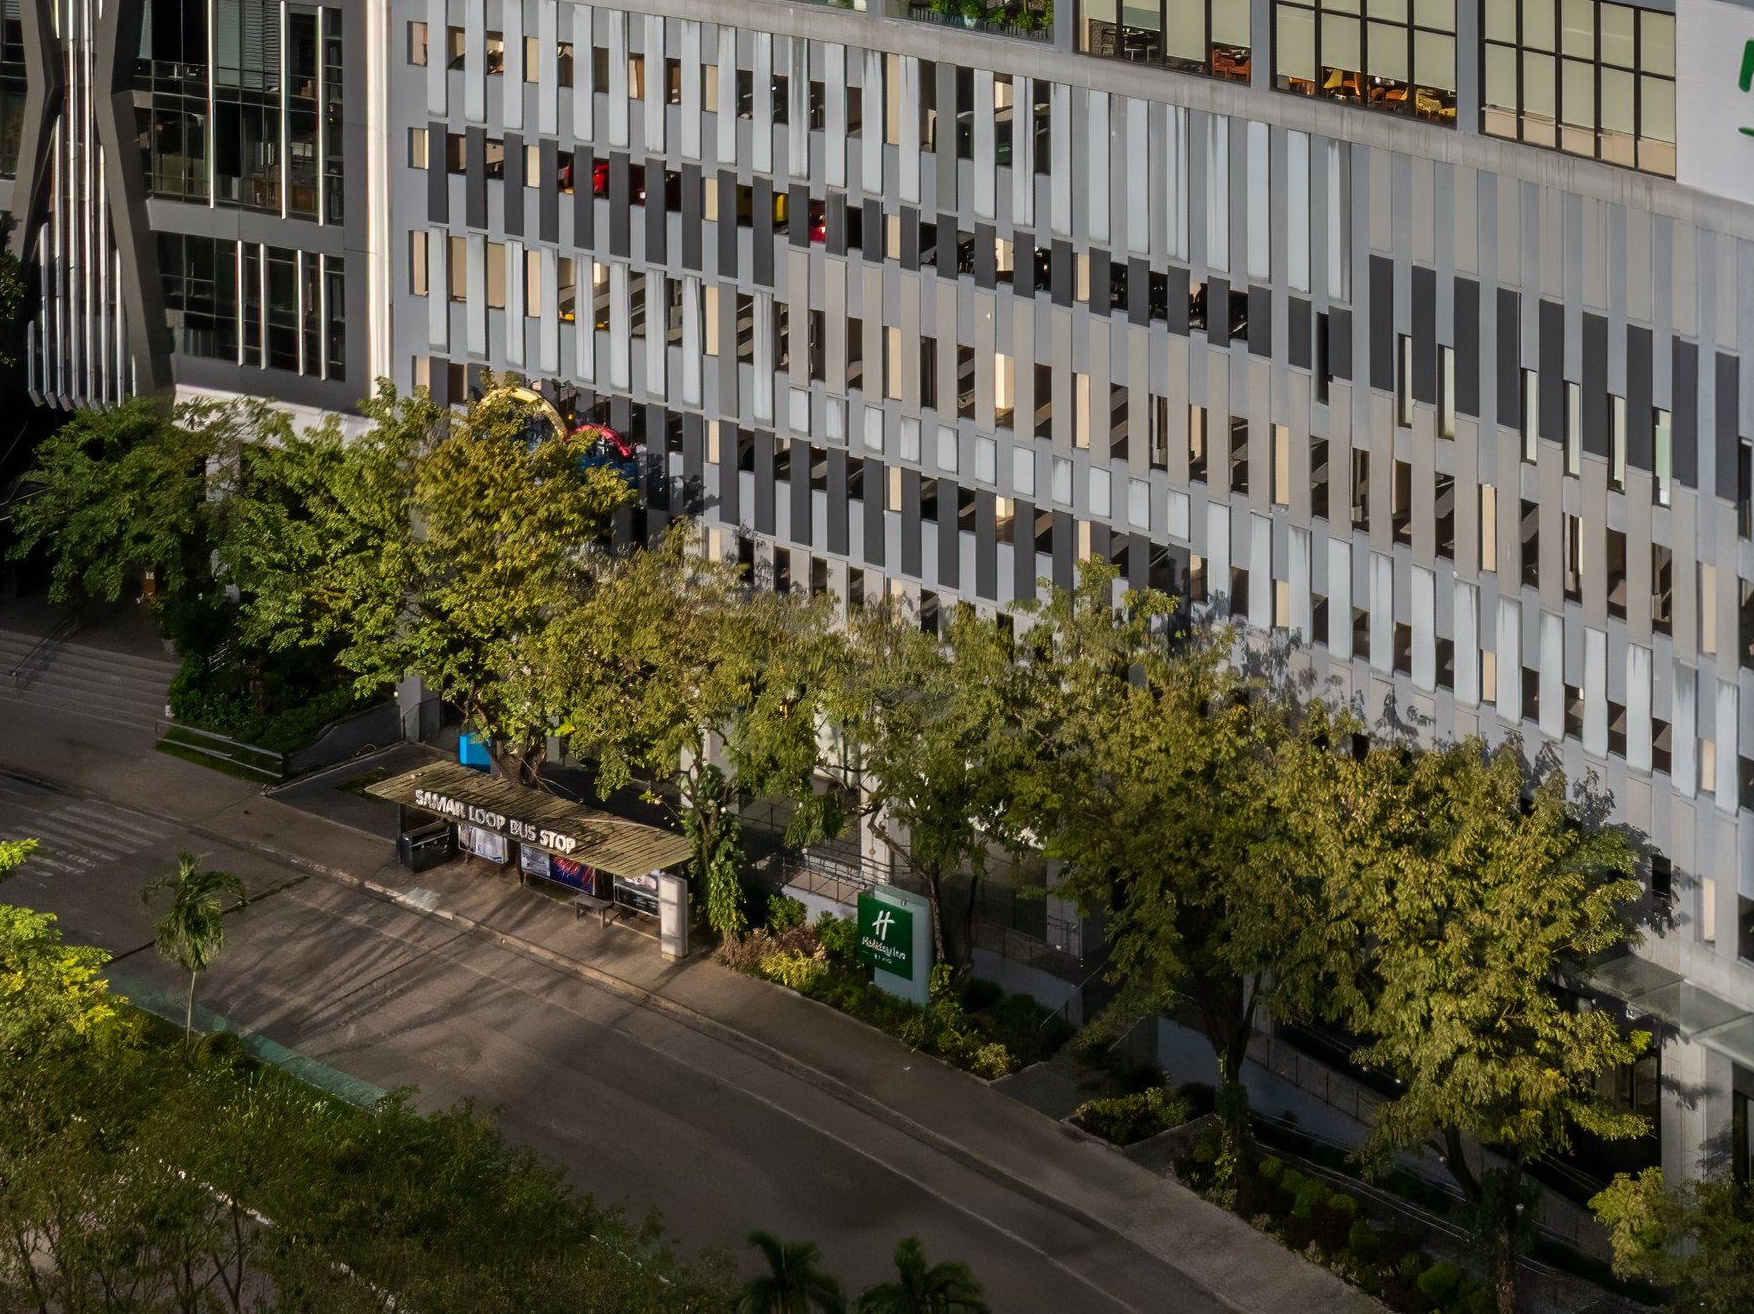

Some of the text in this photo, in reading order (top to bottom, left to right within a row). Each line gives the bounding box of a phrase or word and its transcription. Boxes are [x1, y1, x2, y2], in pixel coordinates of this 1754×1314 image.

[415, 789, 577, 855] SAMAR LOOP BUS STOP
